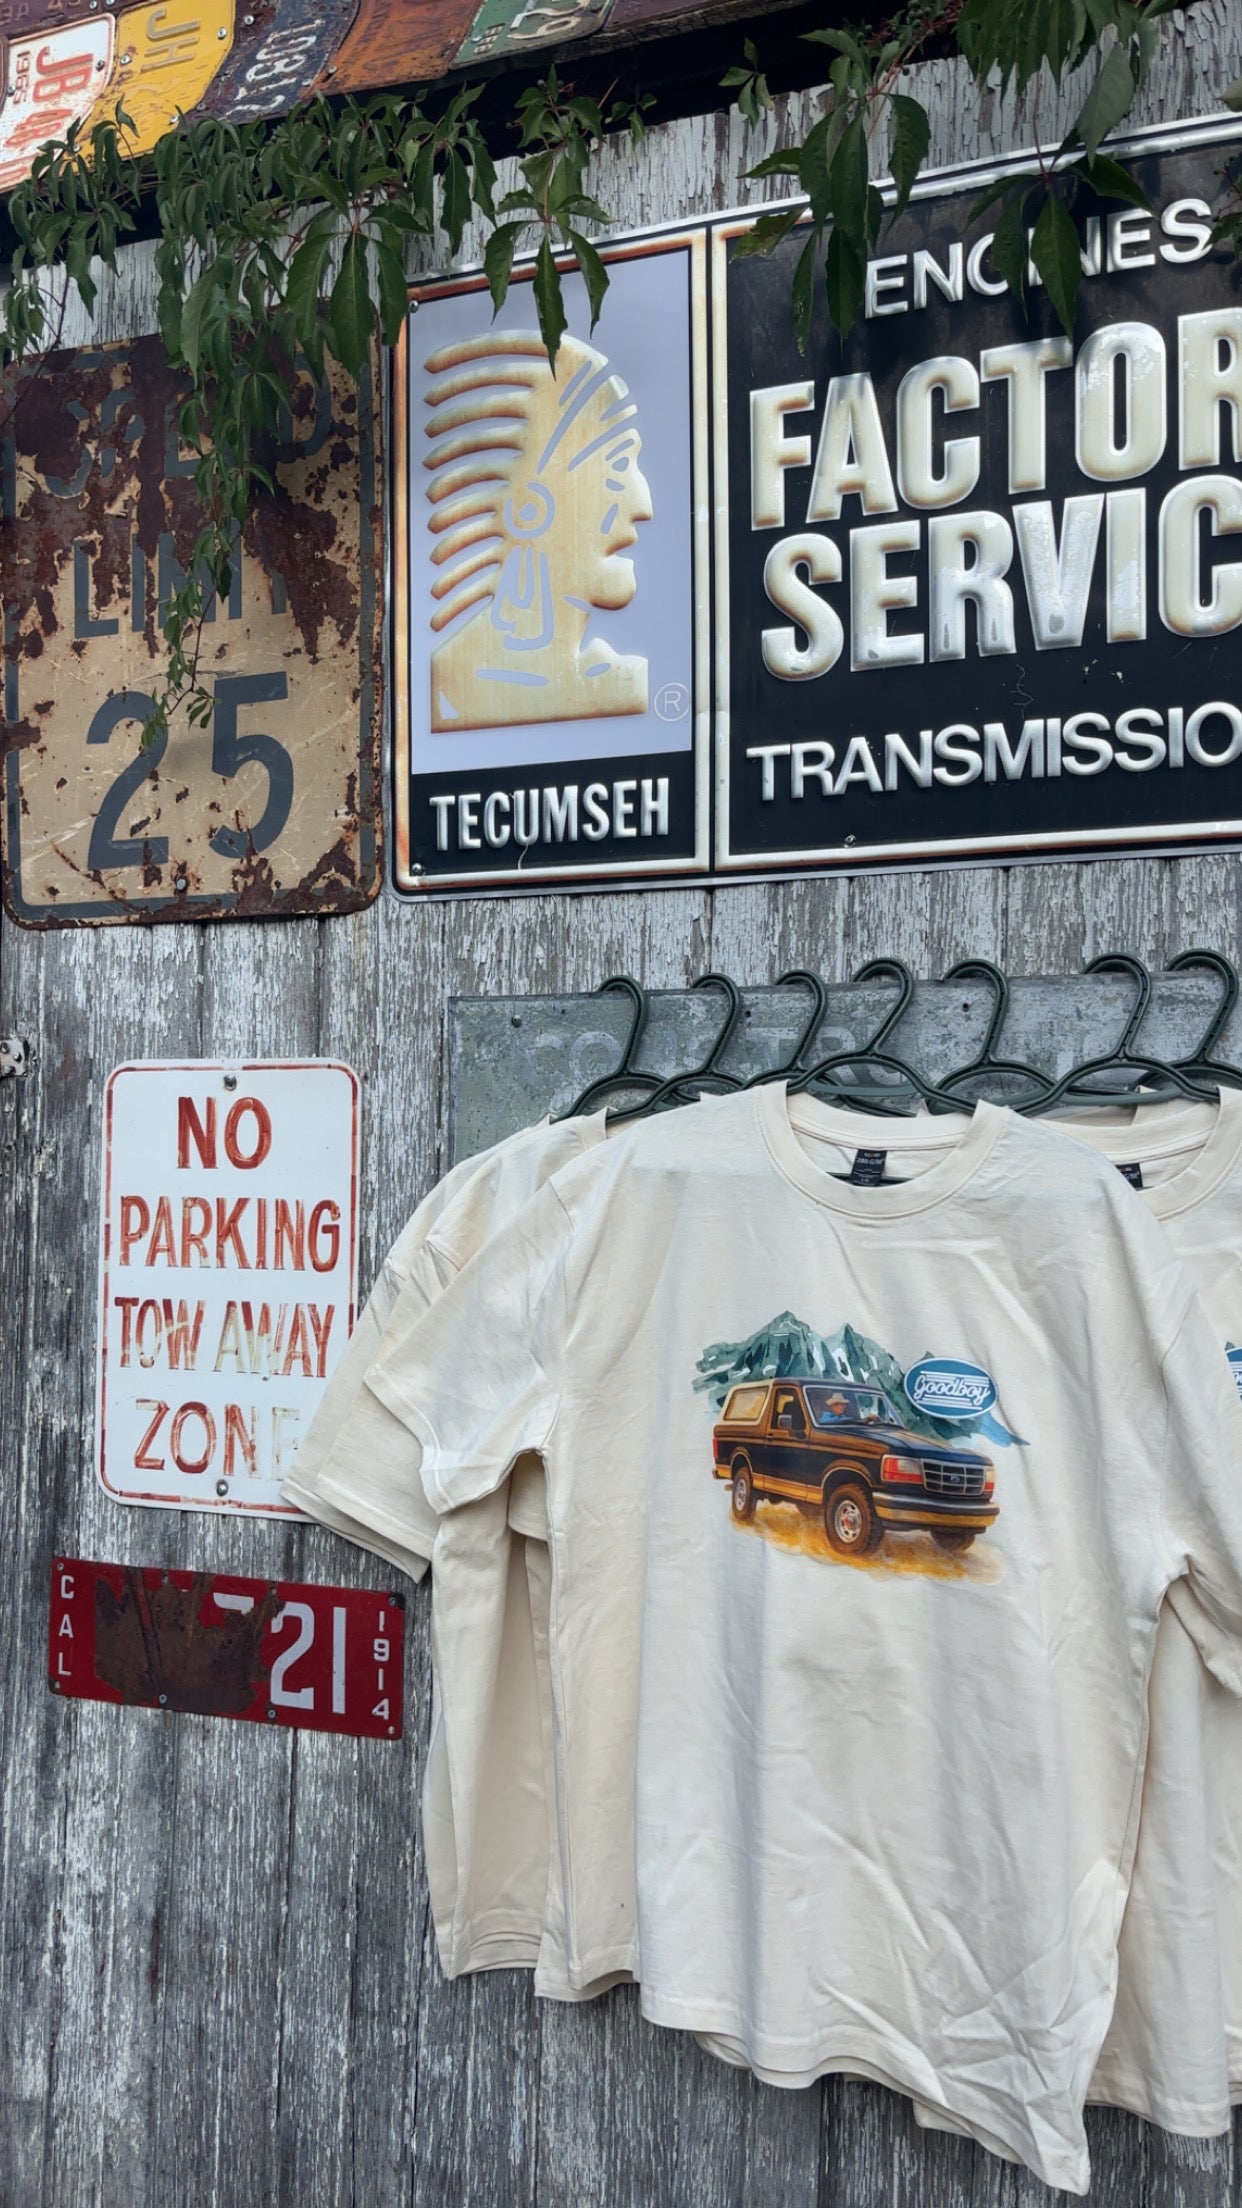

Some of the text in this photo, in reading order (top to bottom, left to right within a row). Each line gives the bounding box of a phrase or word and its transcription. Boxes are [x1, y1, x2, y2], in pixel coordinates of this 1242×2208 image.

[750, 307, 1242, 530] FACTOR
[761, 474, 1242, 682] SERVIC
[86, 671, 295, 870] 25
[429, 777, 670, 852] TECUMSEH
[177, 1096, 273, 1170] NO
[118, 1195, 342, 1273] PARKING
[114, 1296, 336, 1379] TOW AWAY
[913, 1374, 991, 1406] Goodboy
[57, 1574, 75, 1677] CAL
[371, 1610, 391, 1721] 1914
